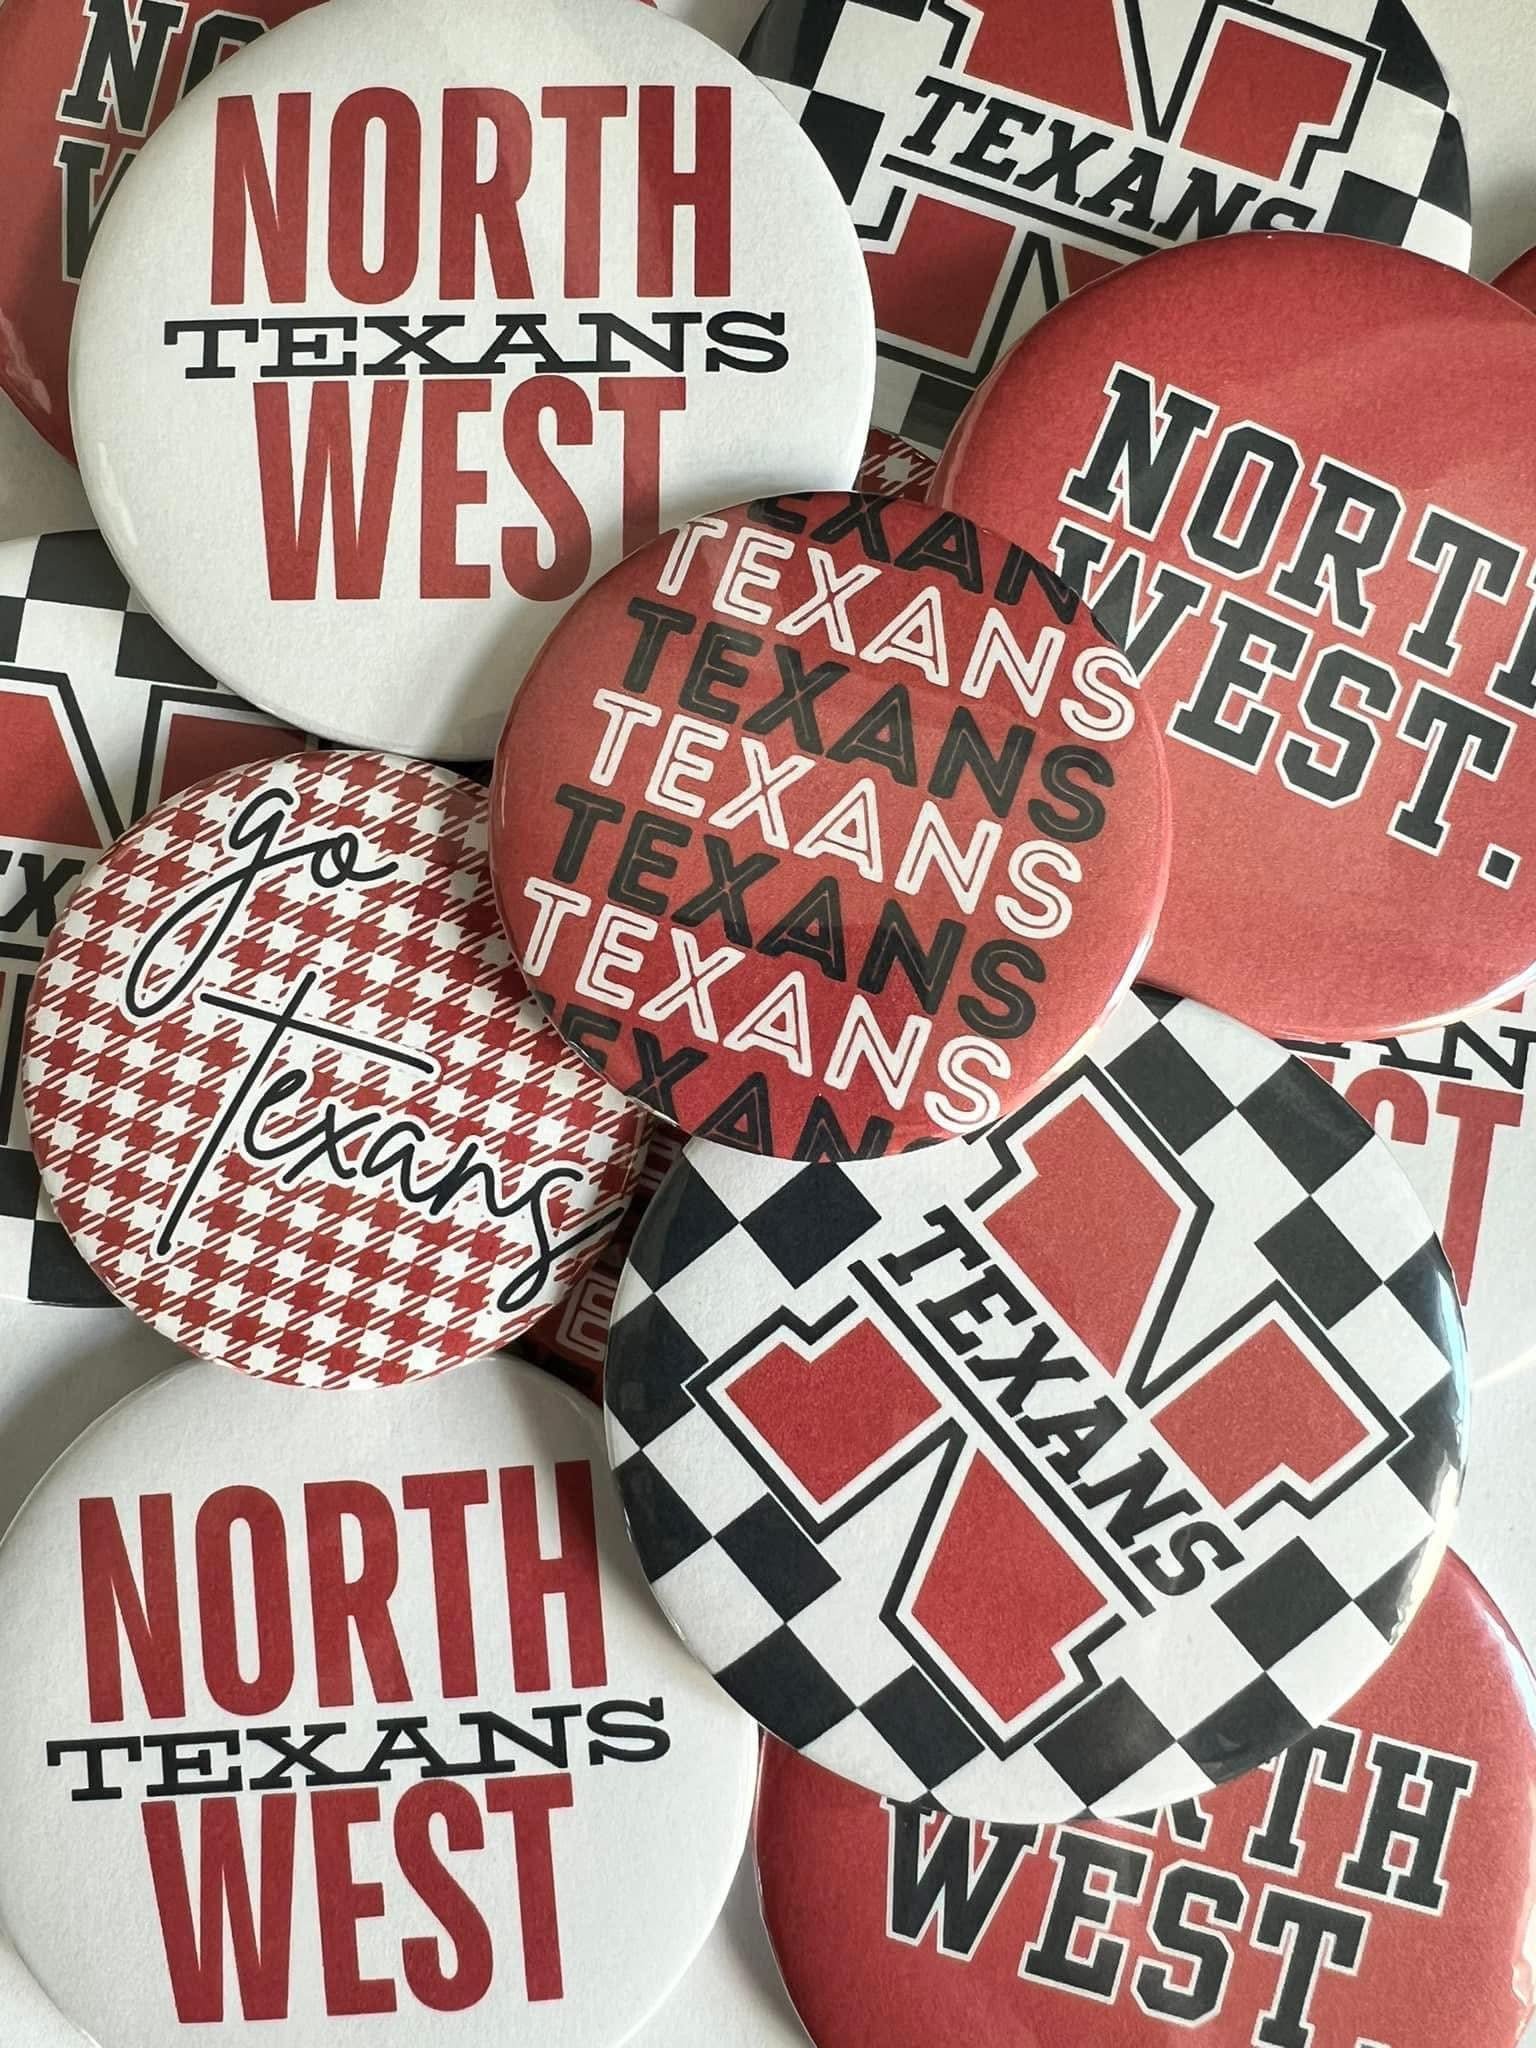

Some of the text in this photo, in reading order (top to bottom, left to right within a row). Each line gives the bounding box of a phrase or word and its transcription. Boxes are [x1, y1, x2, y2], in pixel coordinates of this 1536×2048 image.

[210, 85, 732, 305] NORTH
[164, 311, 789, 379] TEXANS
[252, 375, 686, 603] WEST
[618, 597, 1115, 843] TEXANS
[655, 517, 1141, 742] TEXANS
[125, 787, 398, 1018] go
[551, 783, 1046, 1039] TEXANS
[588, 688, 1083, 939] TEXANS
[521, 876, 1011, 1134] TEXANS
[157, 971, 625, 1312] Texans
[880, 1204, 1244, 1597] TEXANS
[79, 1459, 608, 1724] NORTH
[46, 1696, 671, 1802] TEXANS
[141, 1772, 574, 2023] WEST
